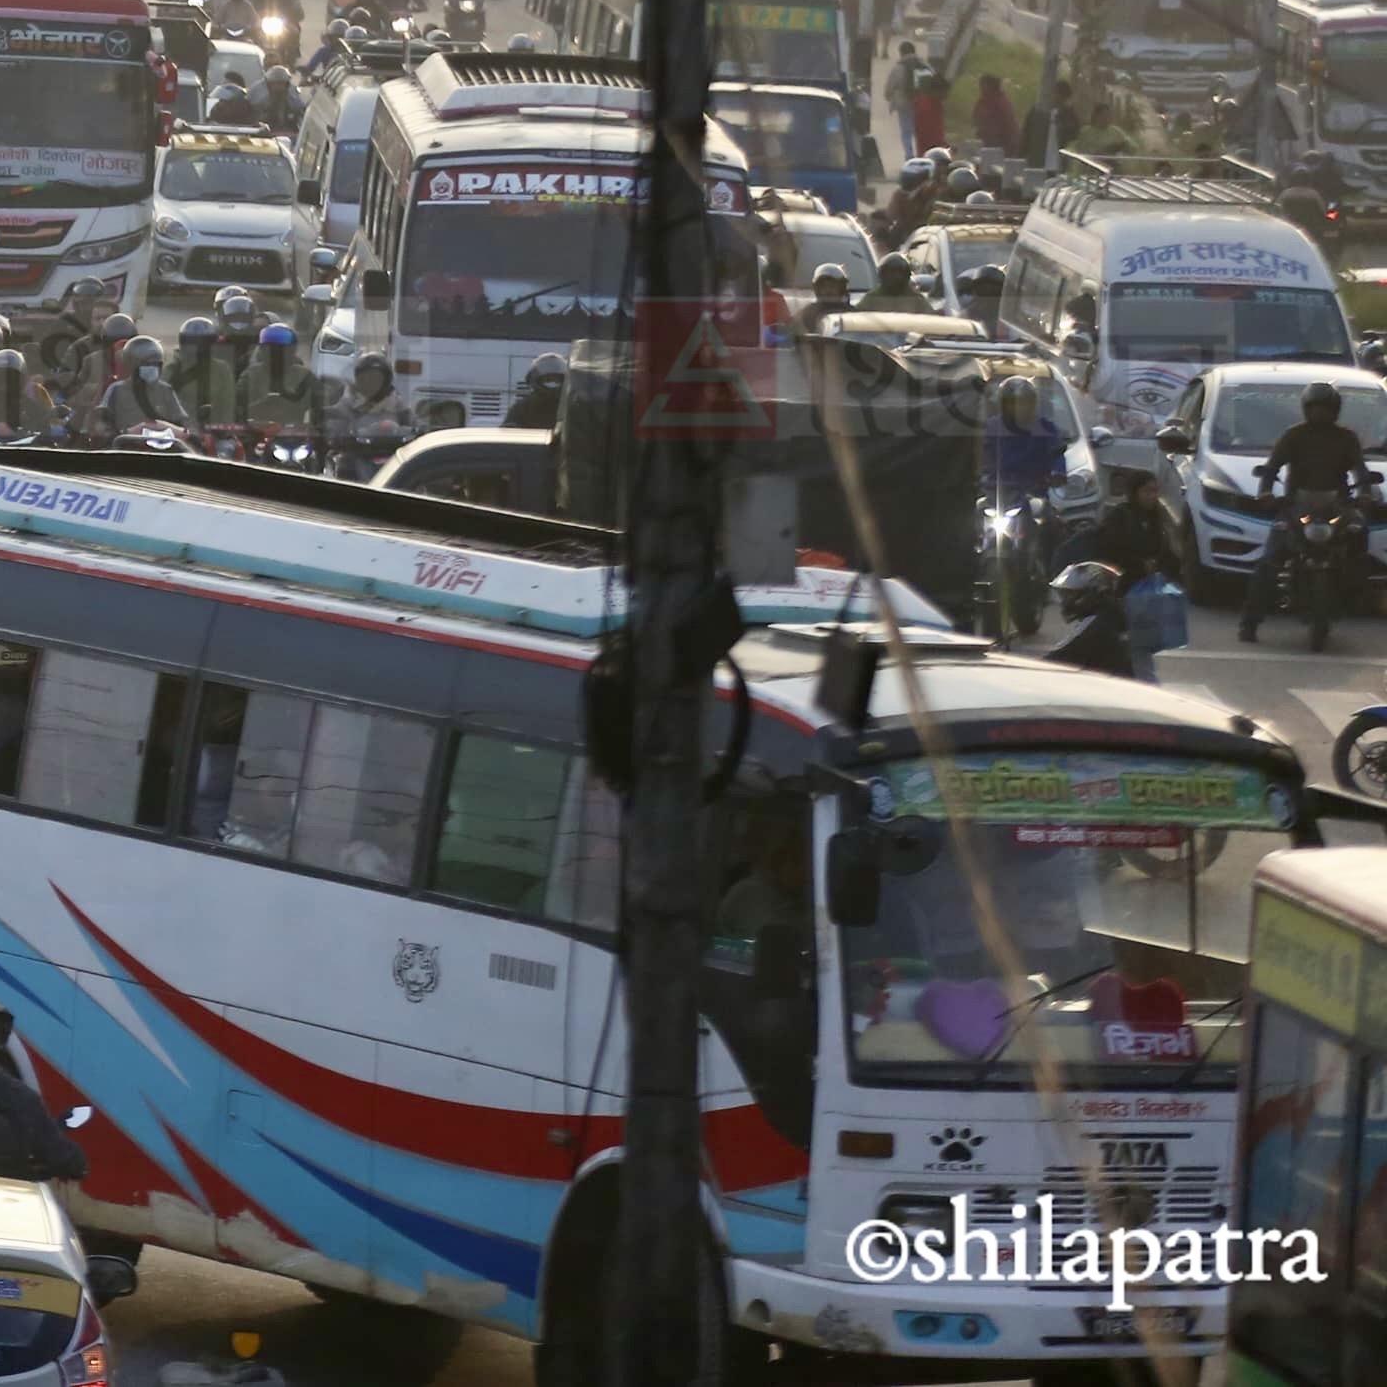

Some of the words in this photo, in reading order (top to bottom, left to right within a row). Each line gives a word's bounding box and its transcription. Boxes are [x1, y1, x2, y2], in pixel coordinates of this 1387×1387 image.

[10, 22, 105, 54] भोजपुर
[1120, 243, 1182, 277] ओम
[413, 562, 487, 596] WiFi
[922, 1161, 987, 1172] KELME
[1099, 1142, 1168, 1167] TATA
